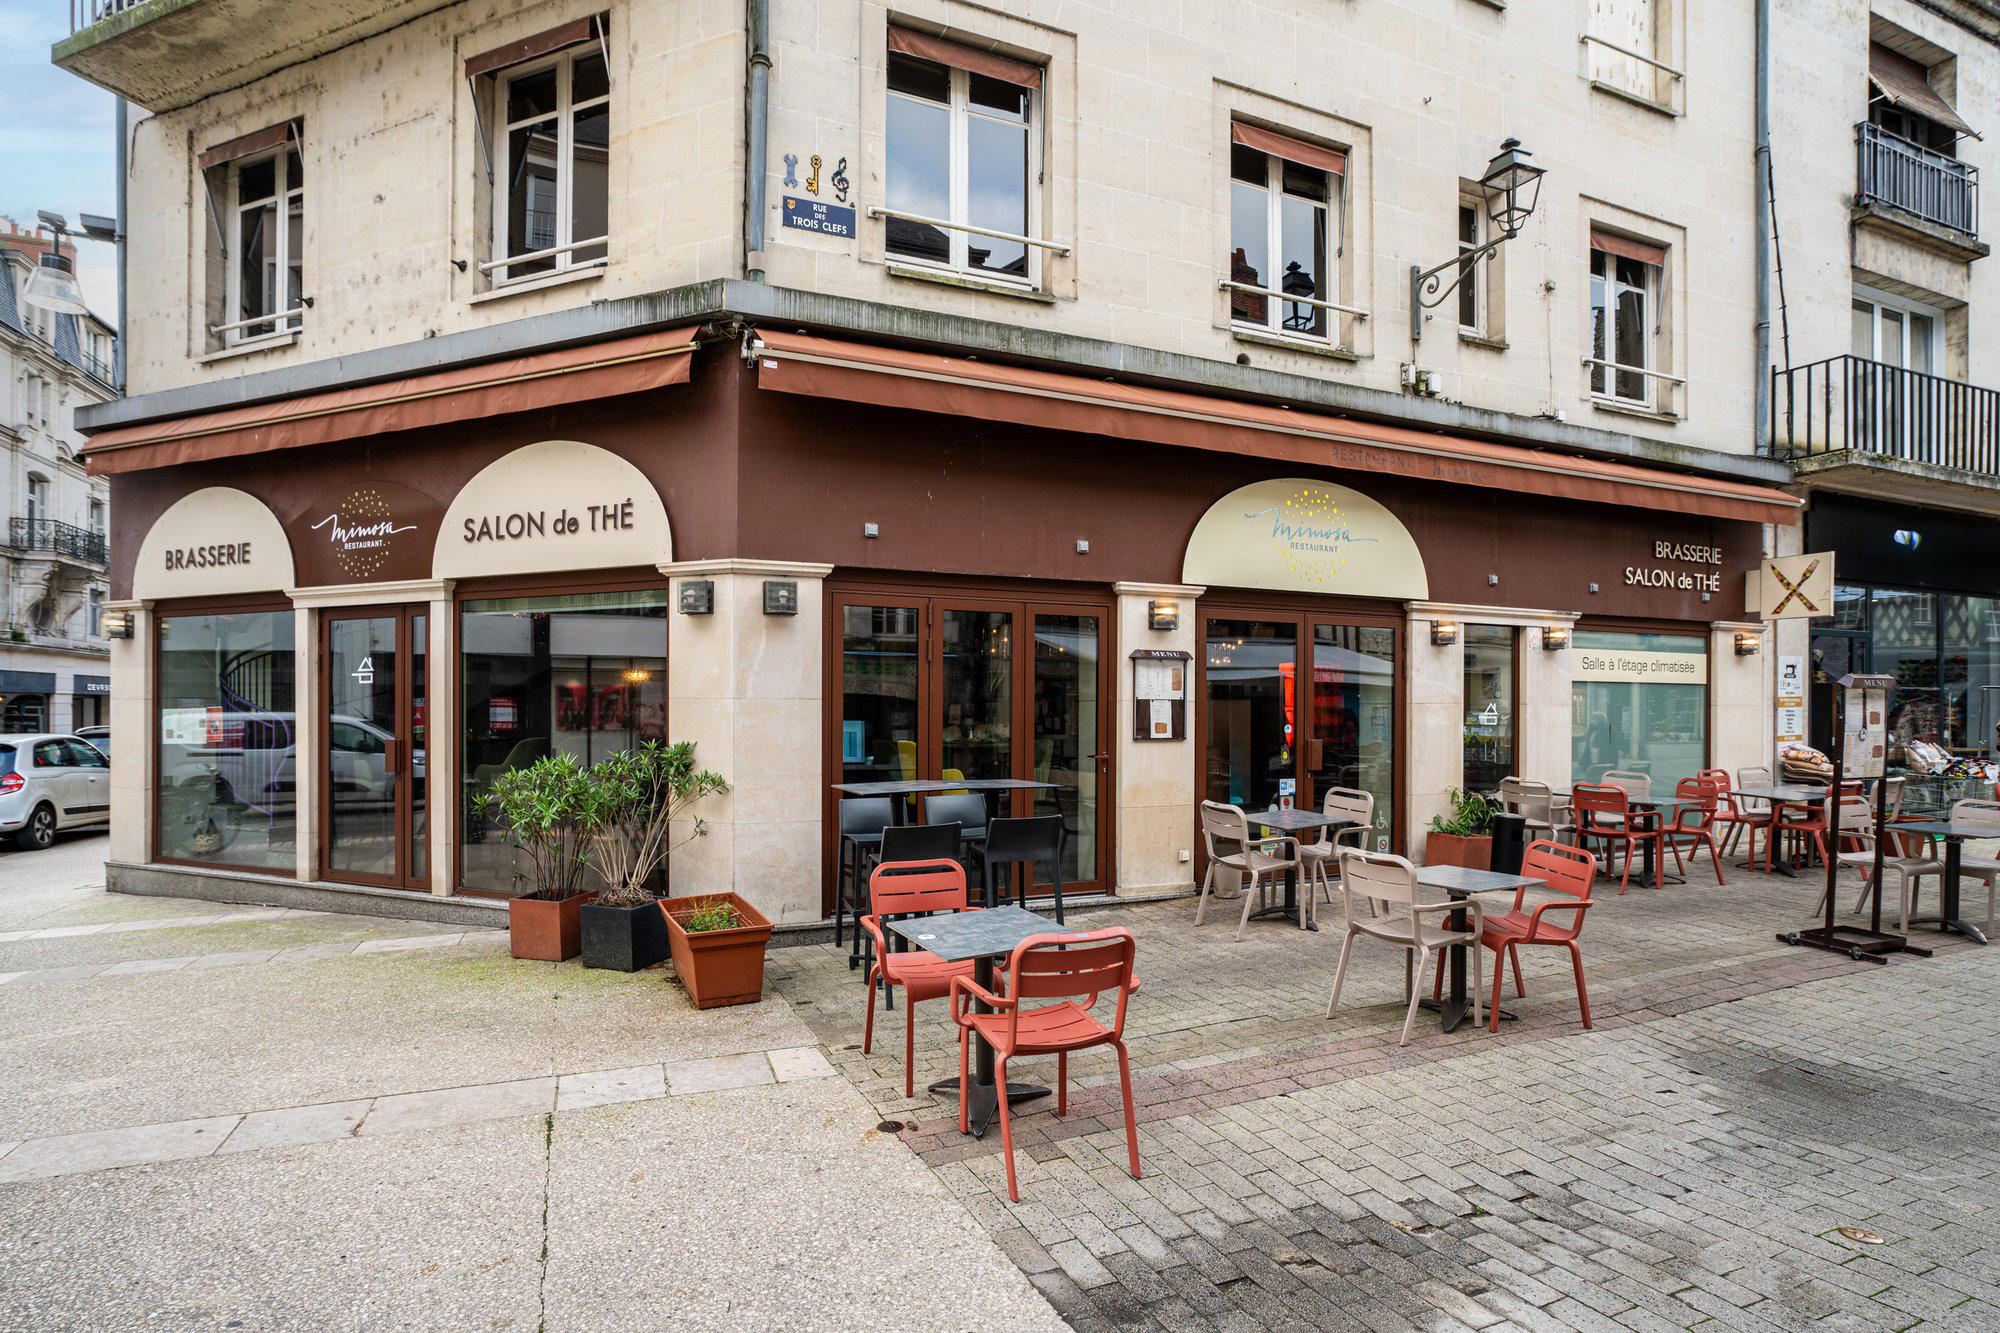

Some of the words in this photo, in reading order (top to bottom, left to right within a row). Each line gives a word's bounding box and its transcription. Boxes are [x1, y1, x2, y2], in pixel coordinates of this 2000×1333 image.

[813, 203, 827, 213] RUE
[792, 216, 819, 229] TROIS
[822, 222, 847, 235] CLEFS
[1331, 447, 1413, 469] RESTAURANT
[463, 510, 545, 544] SALON
[553, 508, 580, 536] de
[587, 497, 634, 533] THÉ
[344, 539, 383, 550] RESTAURANT
[1290, 541, 1338, 553] RESTAURANT
[1655, 540, 1722, 565] BRASSERIE
[165, 542, 251, 571] BRASSERIE
[1625, 566, 1675, 588] SALON
[1677, 571, 1693, 590] de
[1693, 571, 1720, 592] THÉ
[1151, 650, 1180, 658] MENU
[1582, 656, 1606, 671] Salle
[1608, 658, 1615, 671] à
[1617, 658, 1648, 675] l'étage
[1650, 659, 1696, 674] climatisée
[1864, 679, 1888, 687] MENU
